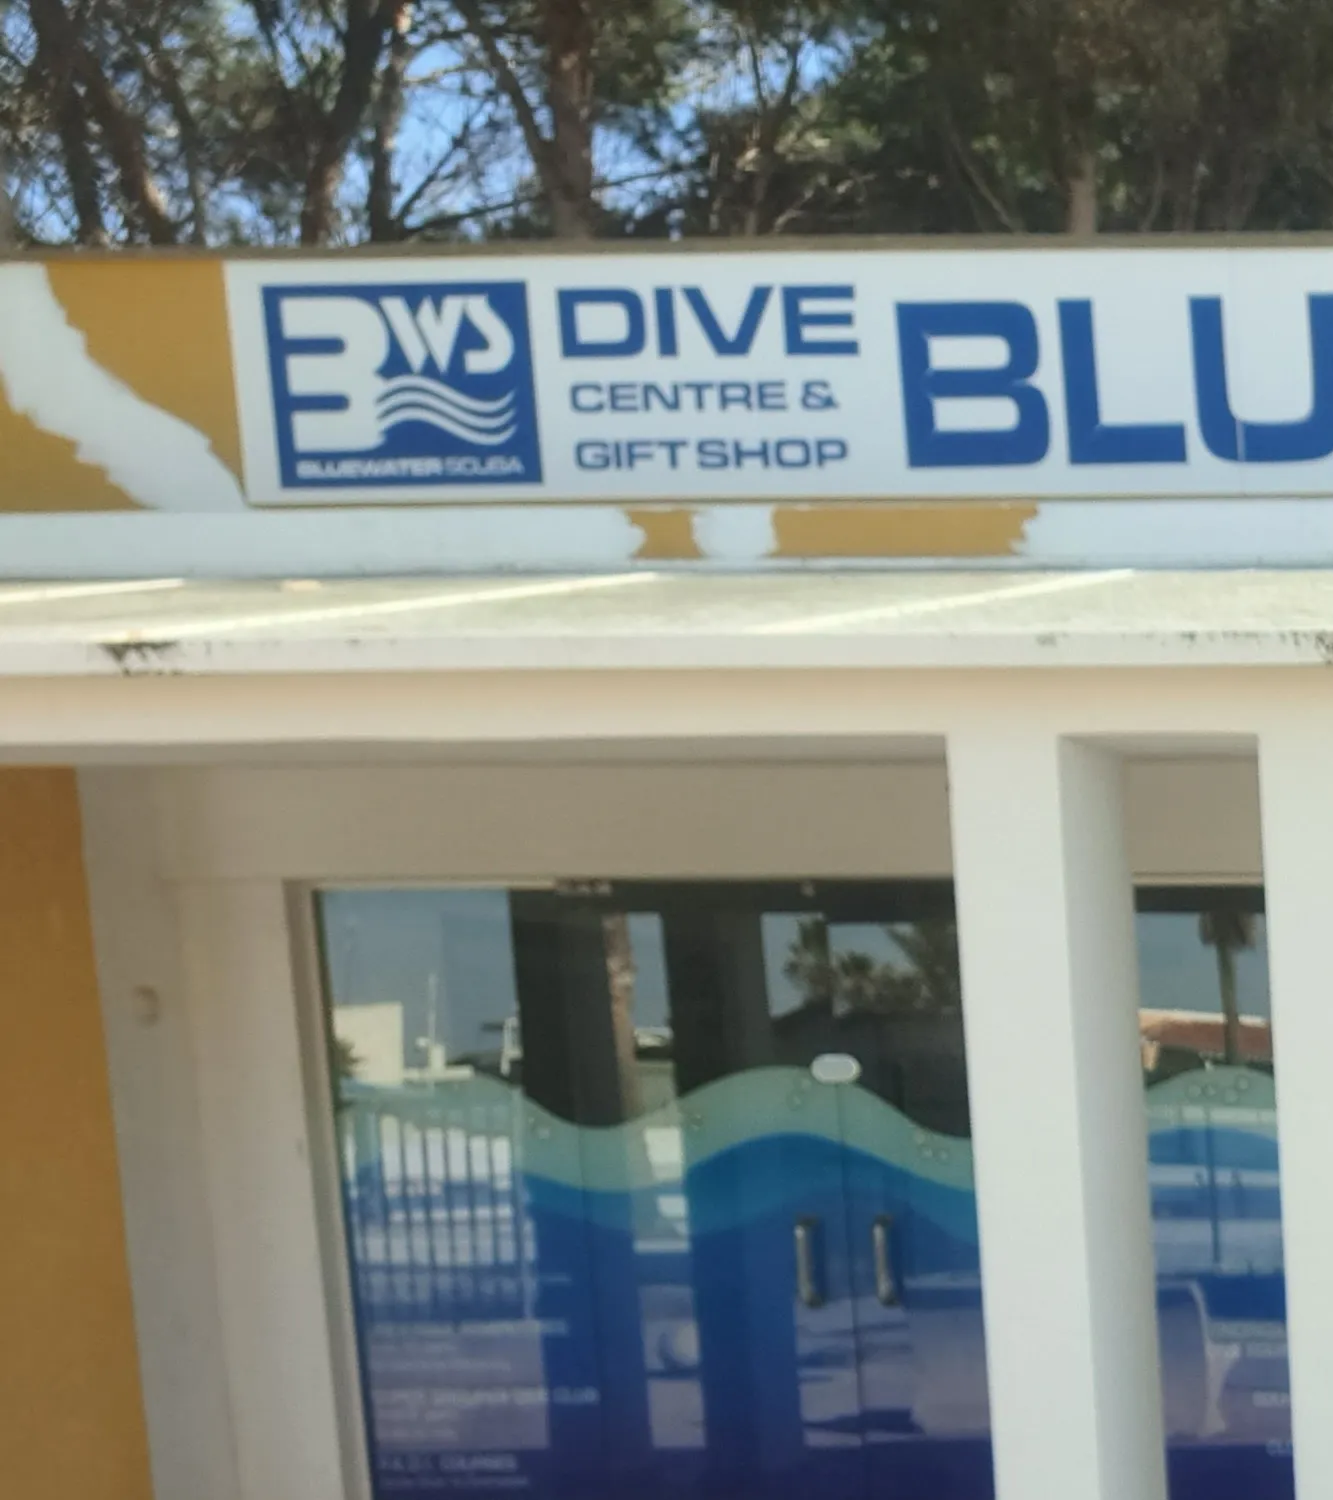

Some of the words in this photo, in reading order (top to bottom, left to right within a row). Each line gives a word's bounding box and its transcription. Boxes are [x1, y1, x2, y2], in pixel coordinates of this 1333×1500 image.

[556, 284, 860, 359] DIVE
[569, 380, 788, 414] CENTRE
[799, 379, 839, 411] &
[573, 438, 690, 472] GIFT
[695, 437, 849, 471] SHOP
